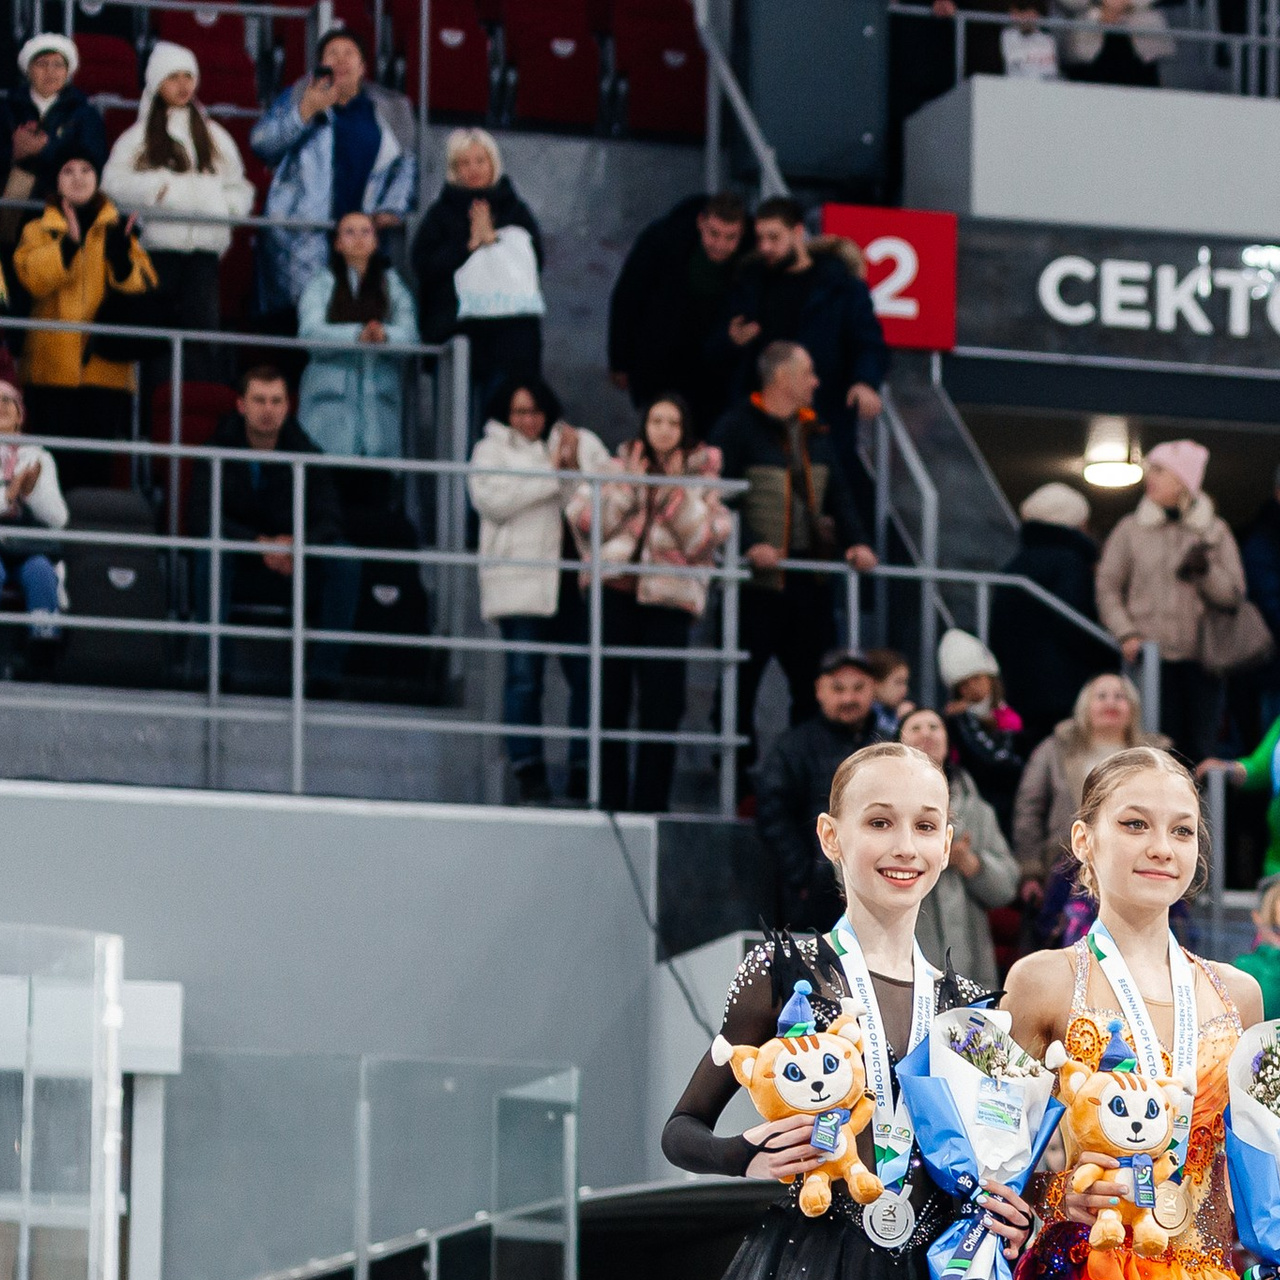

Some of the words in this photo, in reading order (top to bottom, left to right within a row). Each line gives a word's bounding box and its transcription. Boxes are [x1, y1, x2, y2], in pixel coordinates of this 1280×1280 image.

[865, 236, 919, 318] 2
[1117, 978, 1145, 1027] BEGINNING
[869, 1032, 878, 1048] OF
[1140, 1029, 1150, 1042] OF
[1186, 1033, 1194, 1066] ATIONAL
[871, 1049, 886, 1107] VICTORIES
[1144, 1043, 1158, 1080] VICTO
[957, 1175, 973, 1189] sia
